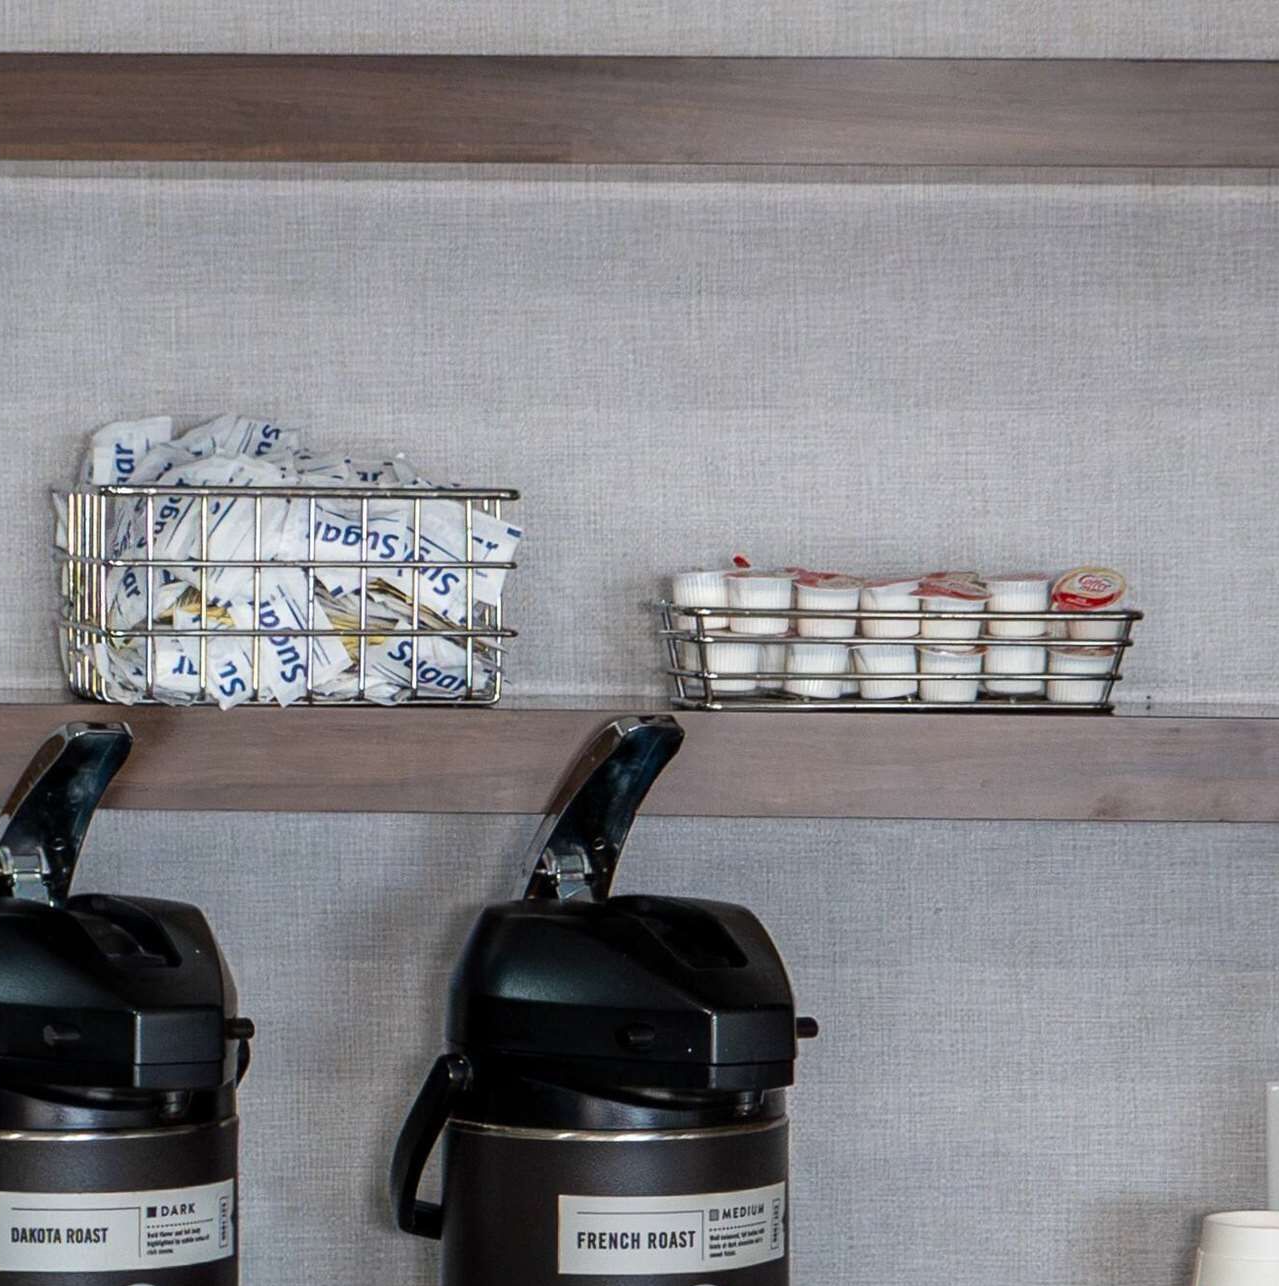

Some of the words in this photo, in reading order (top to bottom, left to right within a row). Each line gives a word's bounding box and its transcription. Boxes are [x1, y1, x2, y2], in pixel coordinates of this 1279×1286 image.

[160, 1202, 196, 1217] DARK
[721, 1203, 765, 1221] MEDIUM
[11, 1226, 62, 1244] DAKOTA
[66, 1227, 109, 1244] ROAST
[576, 1231, 640, 1250] FRENCH
[647, 1230, 697, 1250] ROAST
